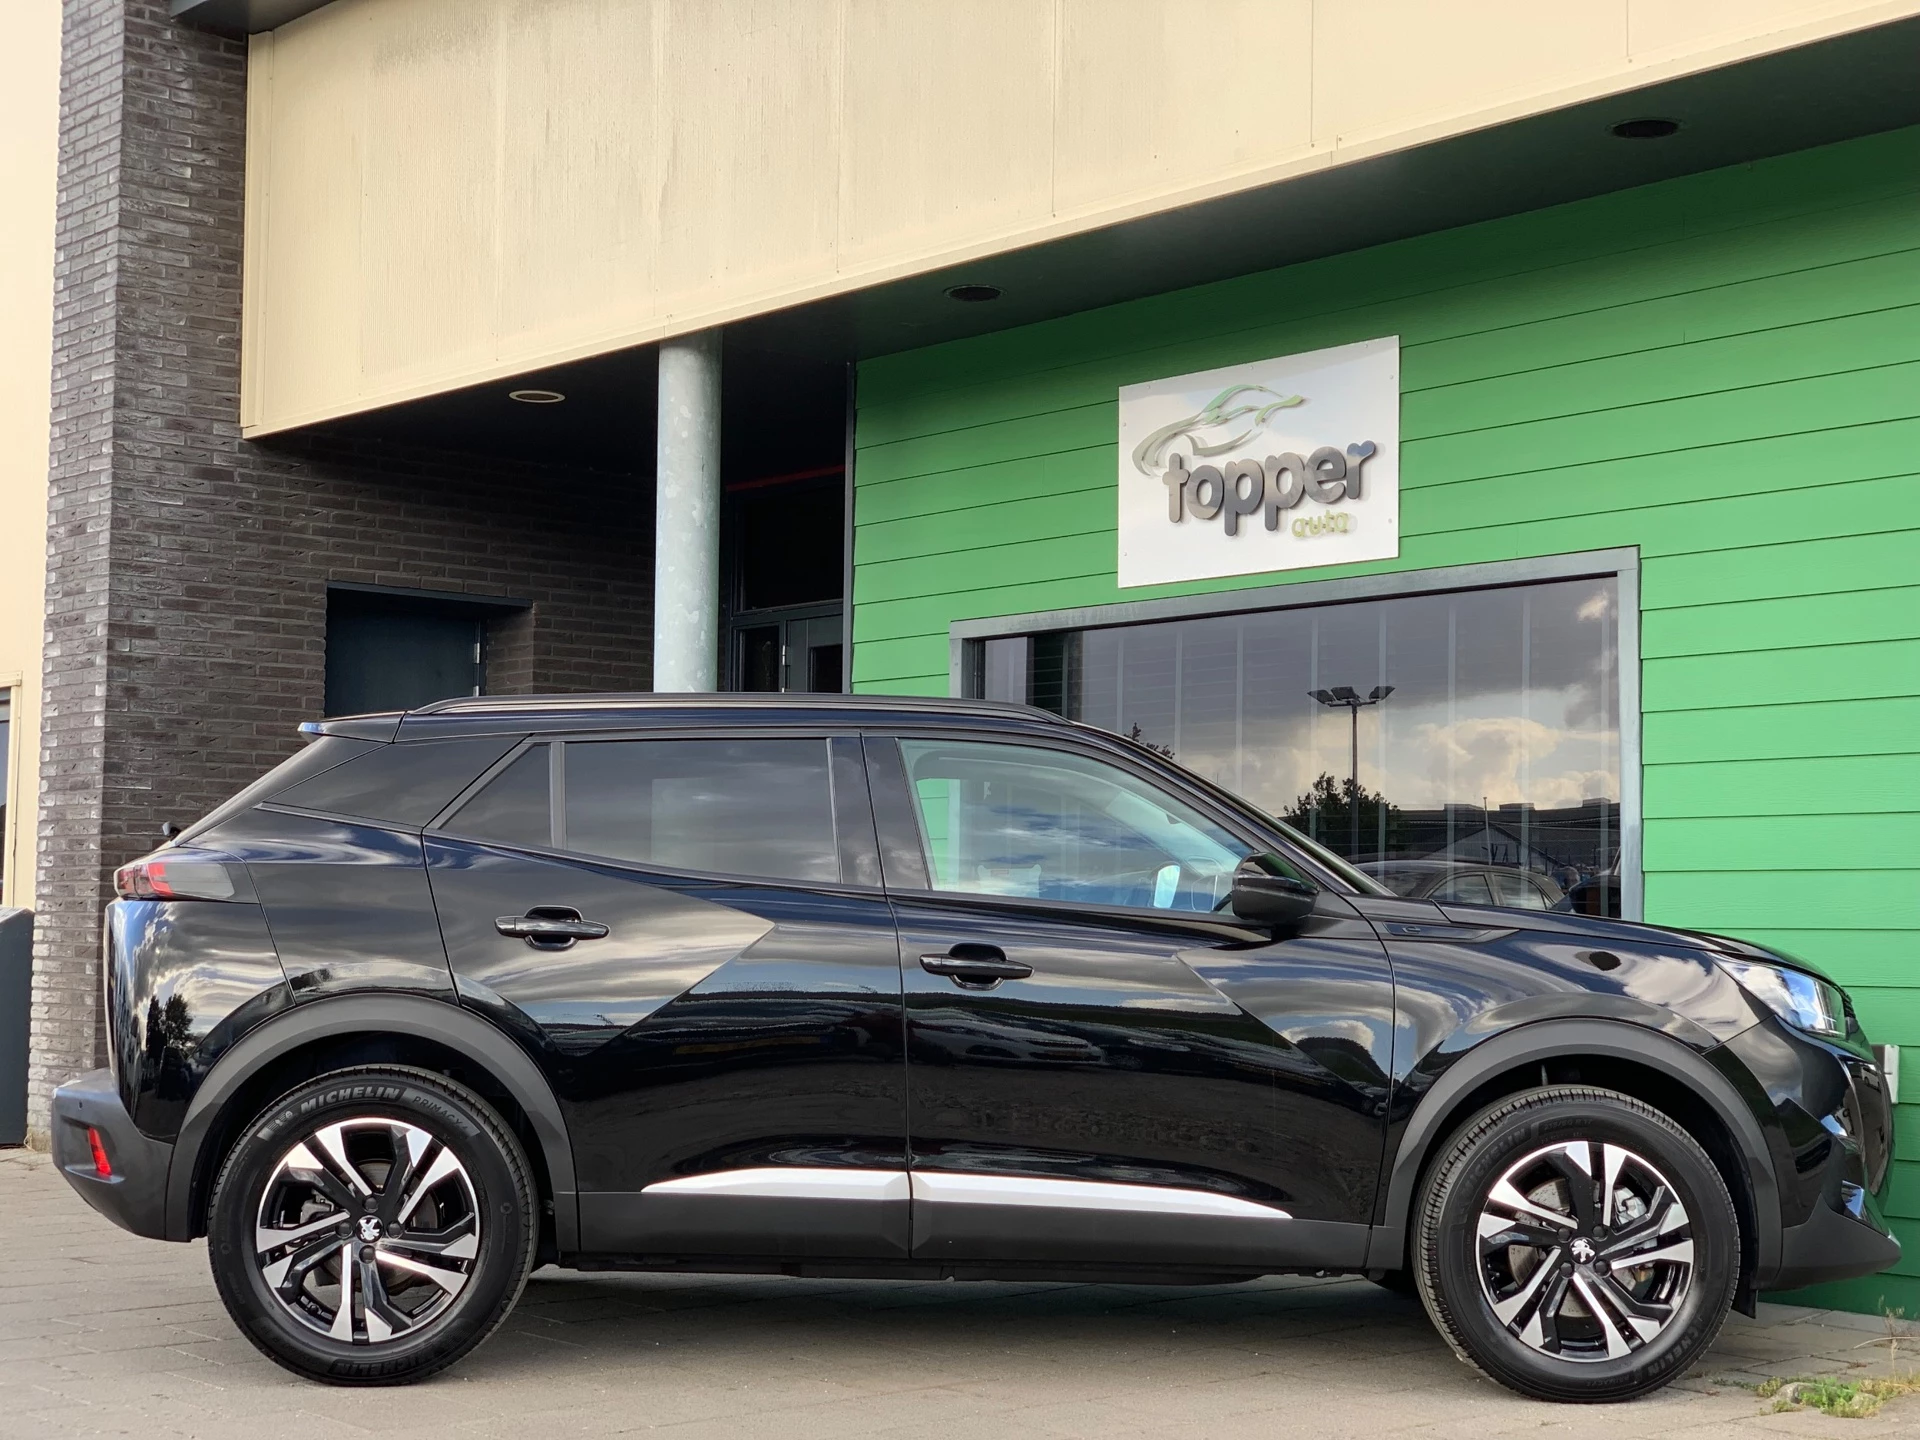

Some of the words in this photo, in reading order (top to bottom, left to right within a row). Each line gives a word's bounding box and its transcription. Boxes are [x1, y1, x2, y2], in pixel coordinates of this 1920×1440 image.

[1162, 440, 1376, 537] topper
[1291, 509, 1350, 538] auto
[300, 1086, 401, 1114] MICHELIN
[412, 1095, 463, 1125] PRIMACY
[1457, 1128, 1526, 1199] MICHELIN
